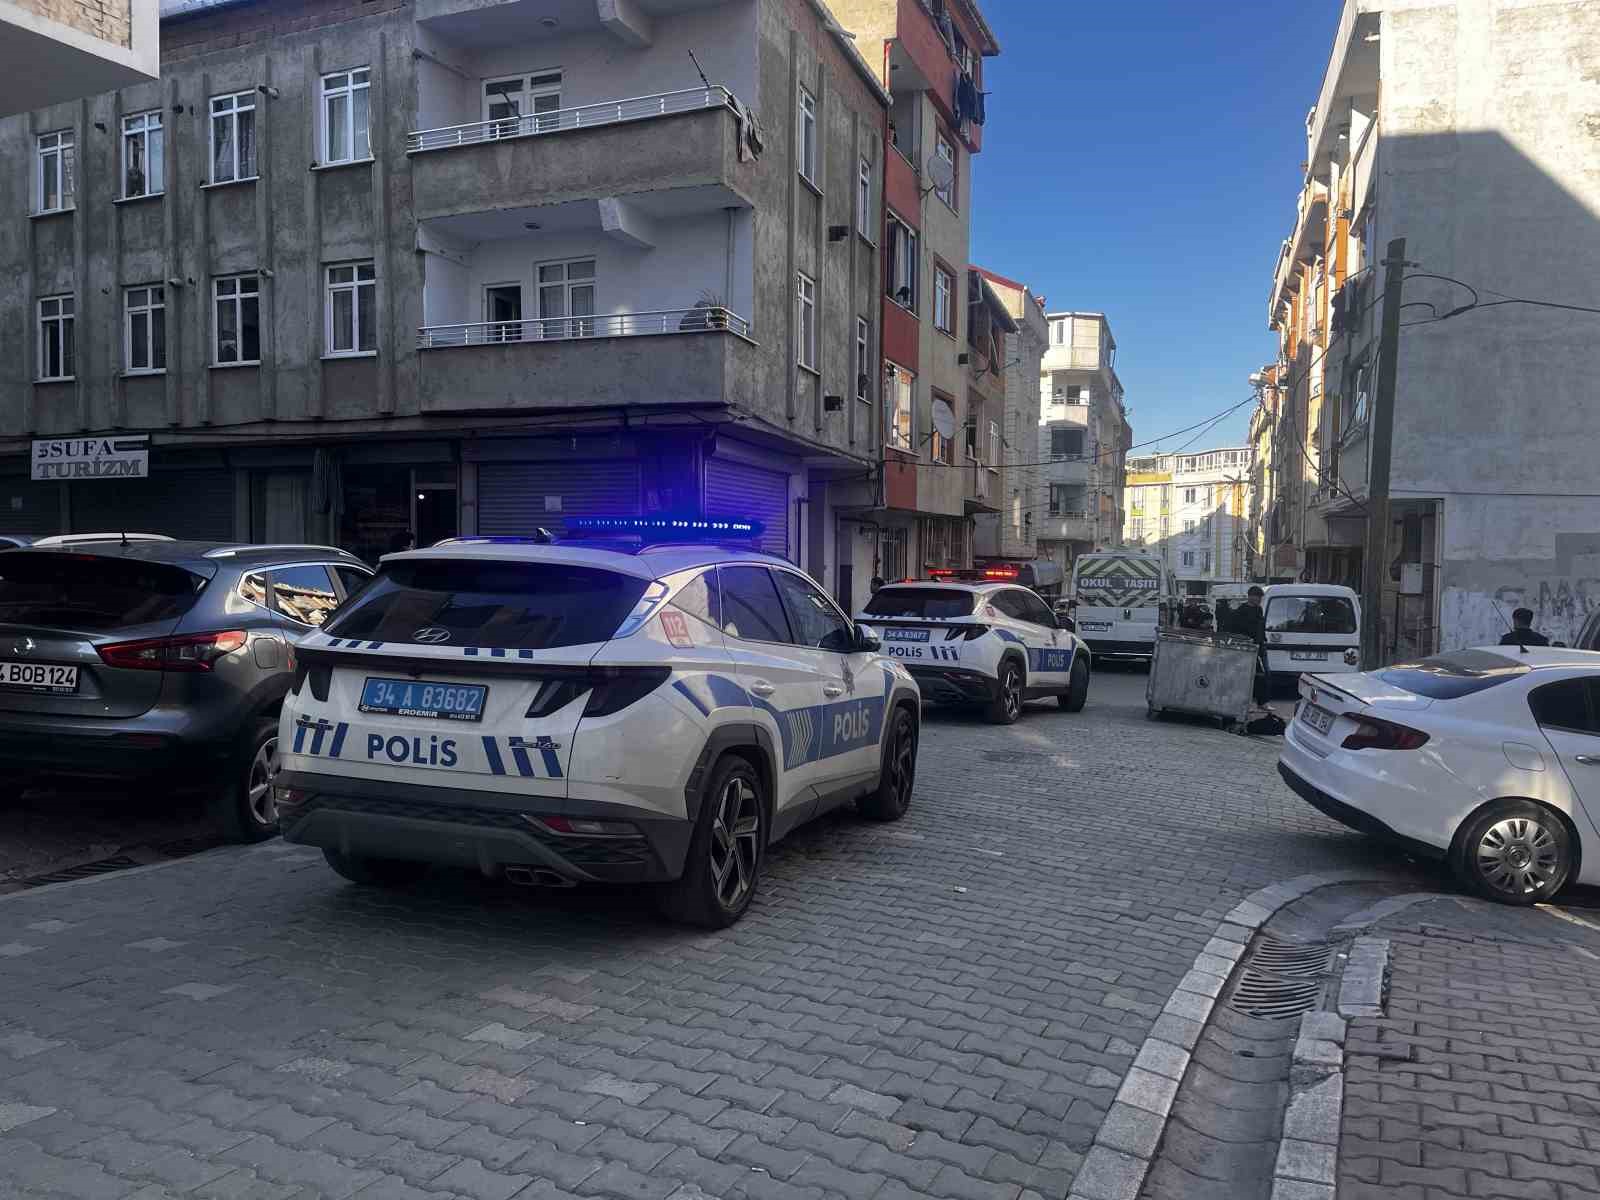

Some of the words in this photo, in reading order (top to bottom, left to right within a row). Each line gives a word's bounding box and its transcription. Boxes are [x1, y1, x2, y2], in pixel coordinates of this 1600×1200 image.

[49, 439, 114, 458] SUFA
[37, 456, 143, 479] TURİZM
[1080, 577, 1113, 588] OKUL
[10, 665, 45, 683] BOB
[49, 668, 74, 685] 124
[374, 683, 395, 705] 34
[402, 685, 413, 706] A
[421, 686, 479, 712] 83682
